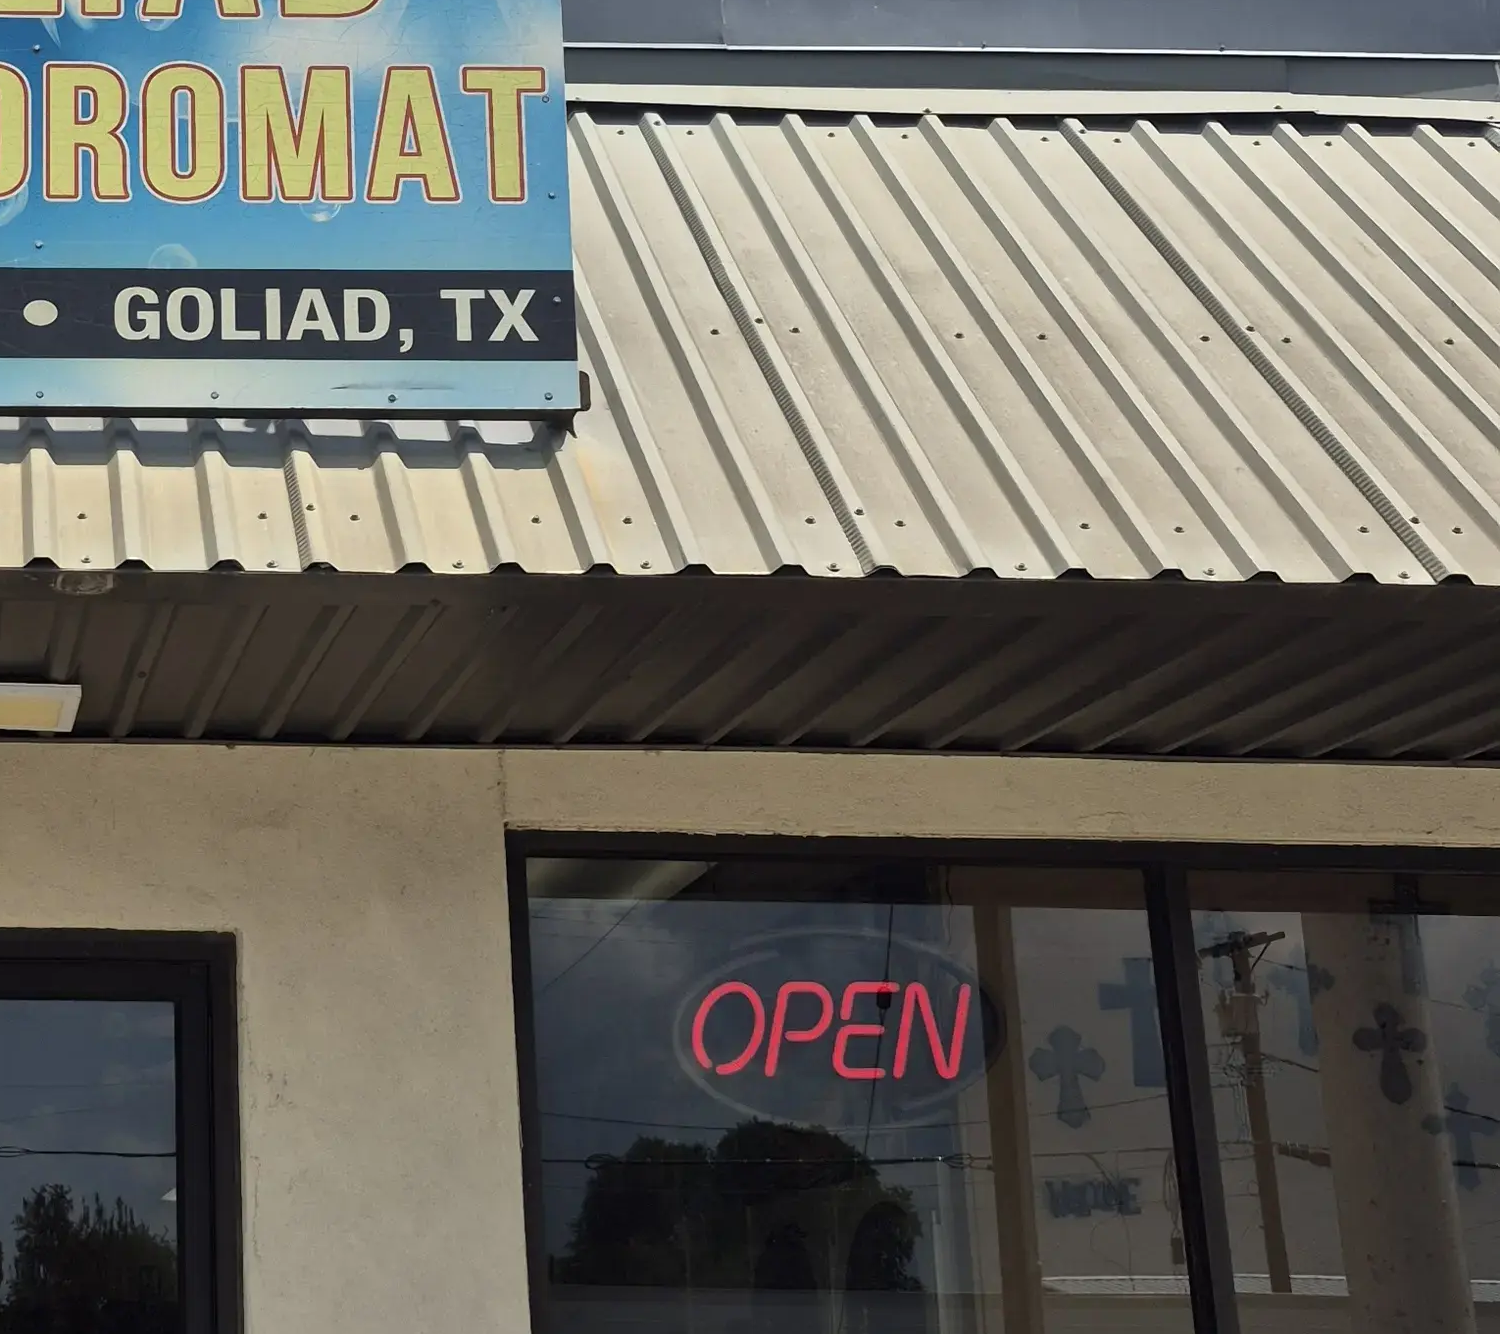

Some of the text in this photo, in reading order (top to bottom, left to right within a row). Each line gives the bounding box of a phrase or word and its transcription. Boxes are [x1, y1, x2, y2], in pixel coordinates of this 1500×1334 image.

[113, 286, 414, 353] GOLIAD,
[440, 288, 539, 343] TX
[691, 981, 971, 1079] OPEN
